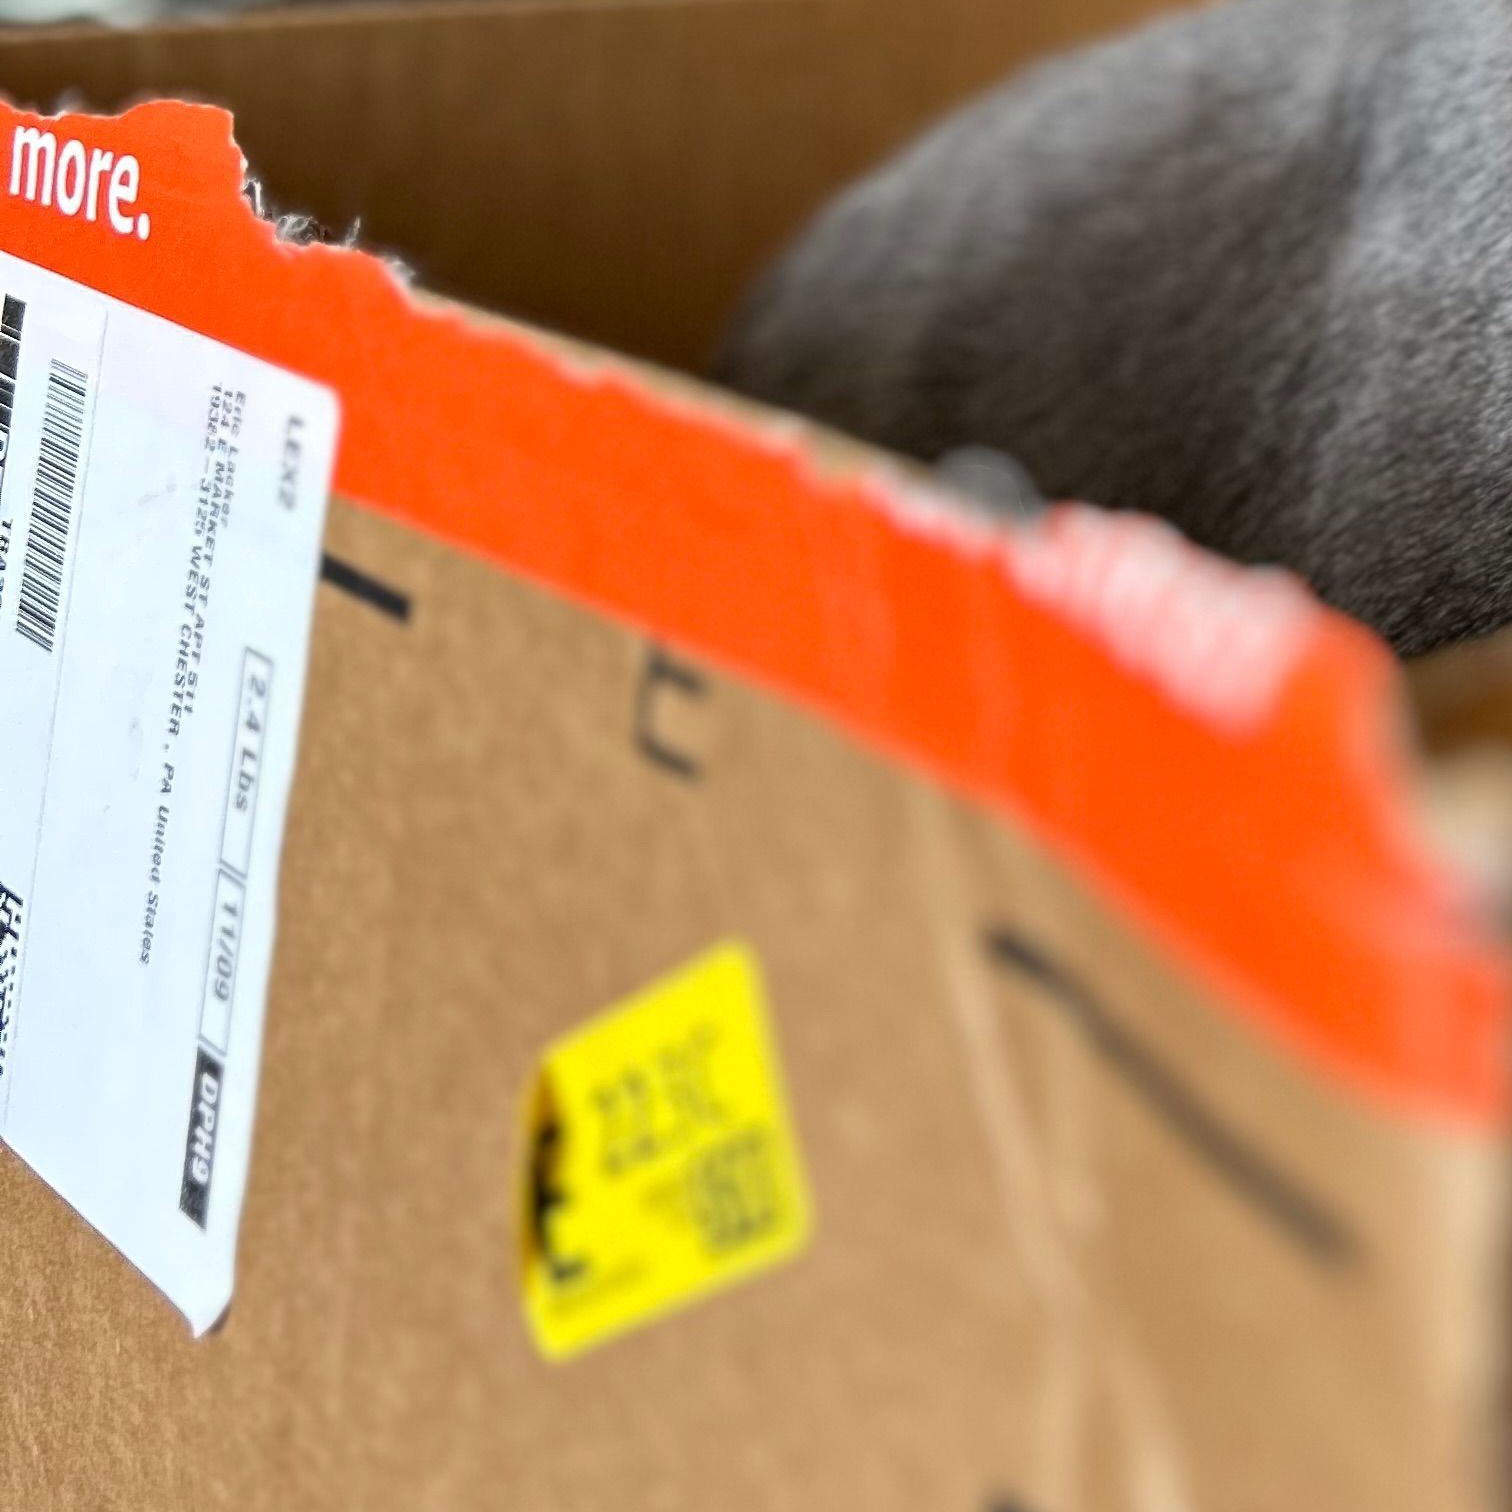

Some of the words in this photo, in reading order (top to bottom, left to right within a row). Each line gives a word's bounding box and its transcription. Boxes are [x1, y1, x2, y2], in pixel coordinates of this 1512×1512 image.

[9, 125, 151, 241] more.
[230, 391, 246, 438] Eric
[204, 461, 225, 567] MARKET
[184, 545, 203, 616] WEST
[198, 575, 210, 608] ST
[190, 613, 205, 664] APT
[246, 674, 266, 733] 2.4
[160, 762, 175, 794] PA
[235, 746, 257, 813] Lbs
[150, 805, 169, 884] United
[139, 891, 158, 966] States
[213, 902, 238, 1002] 11/09
[192, 1071, 219, 1186] DPH9
